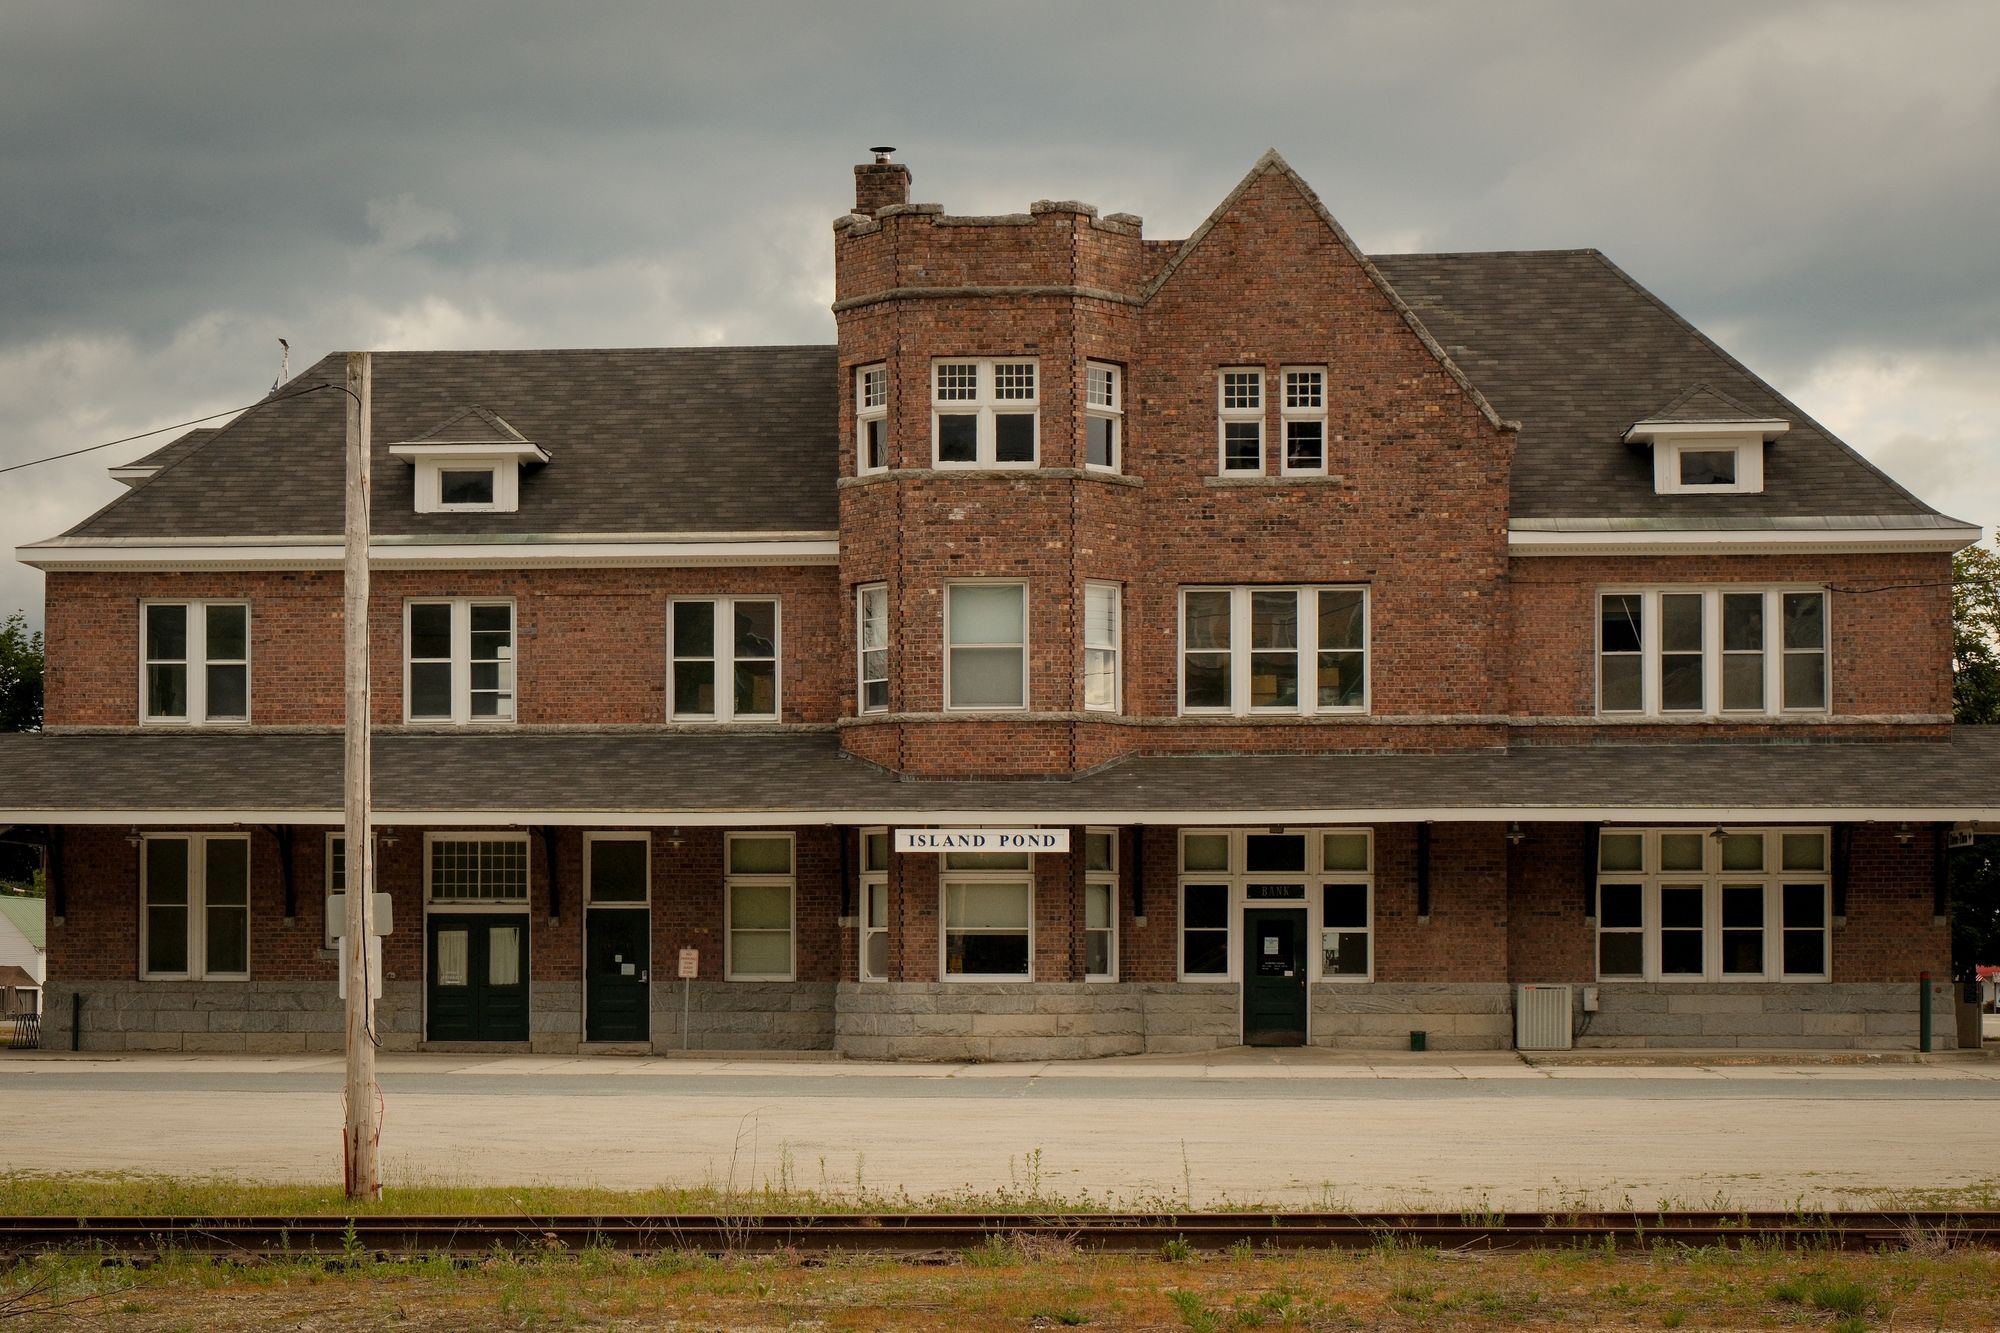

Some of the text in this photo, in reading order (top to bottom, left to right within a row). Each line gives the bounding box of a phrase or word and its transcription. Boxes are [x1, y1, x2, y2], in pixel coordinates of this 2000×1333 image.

[909, 834, 1056, 847] ISLAND POND
[1261, 885, 1290, 897] BANK
